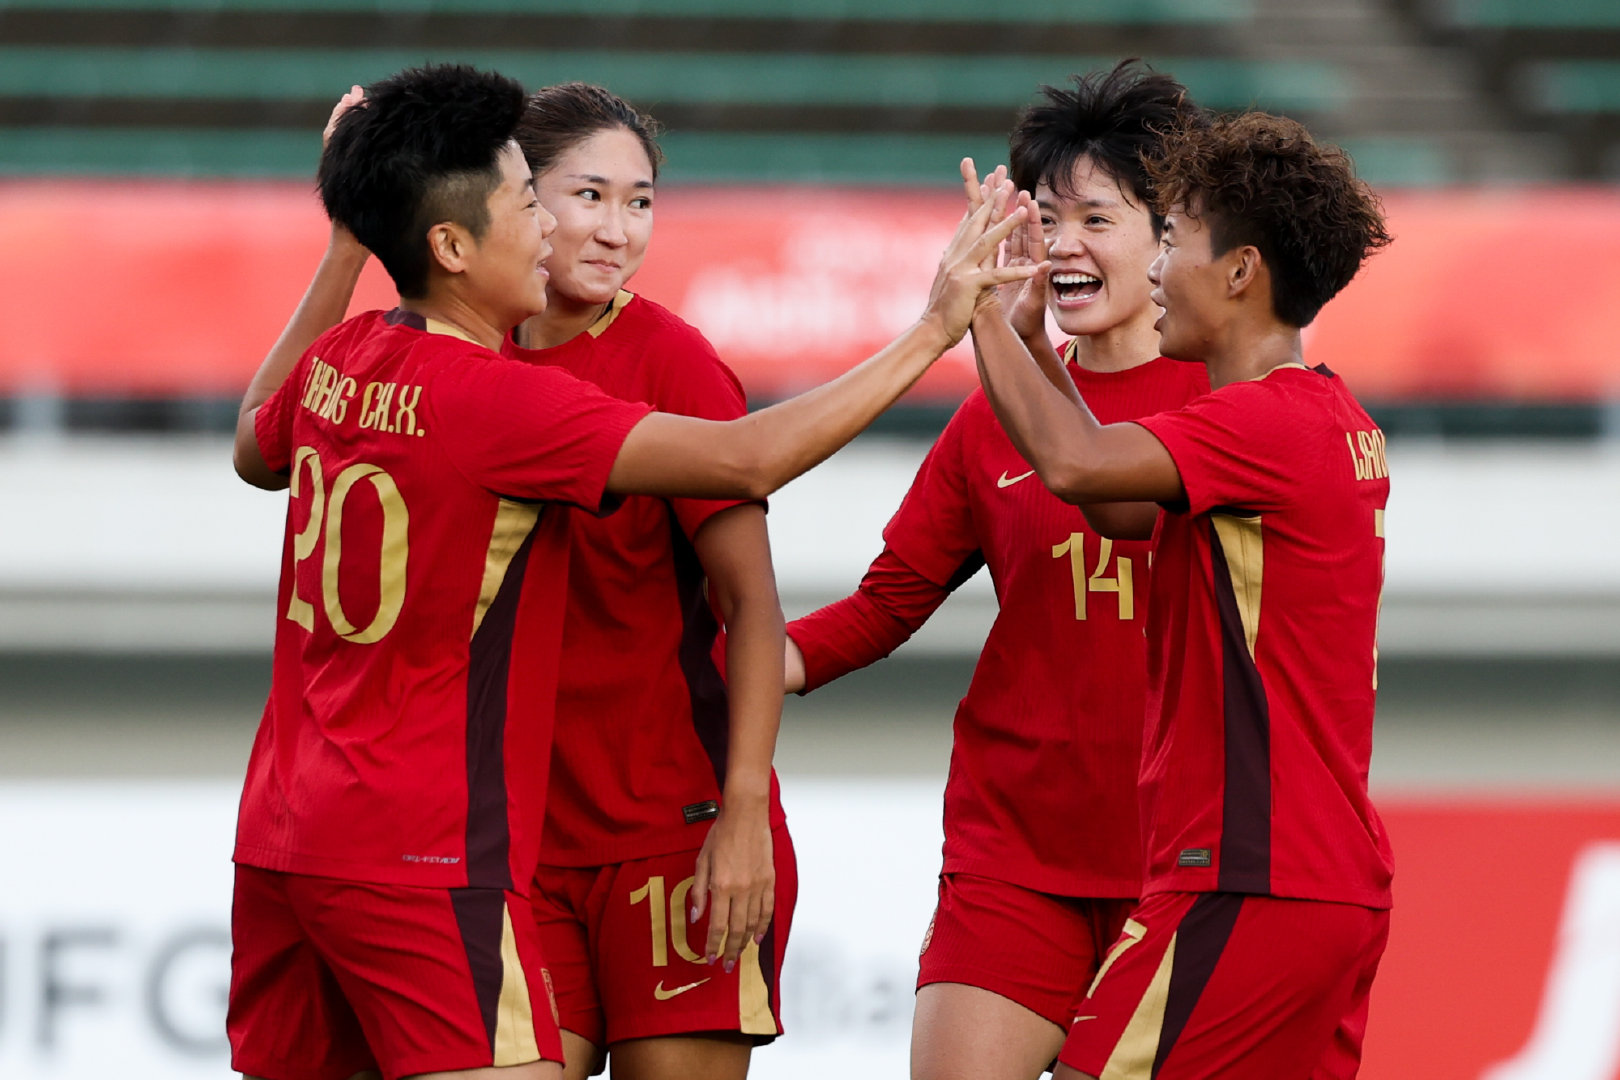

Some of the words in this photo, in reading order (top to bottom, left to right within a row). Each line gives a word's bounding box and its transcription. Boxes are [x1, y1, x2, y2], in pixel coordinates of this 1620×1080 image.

[359, 381, 425, 437] CH.X.
[286, 446, 409, 644] 20
[1052, 532, 1134, 620] 14
[630, 875, 730, 967] 10
[0, 922, 232, 1056] FG
